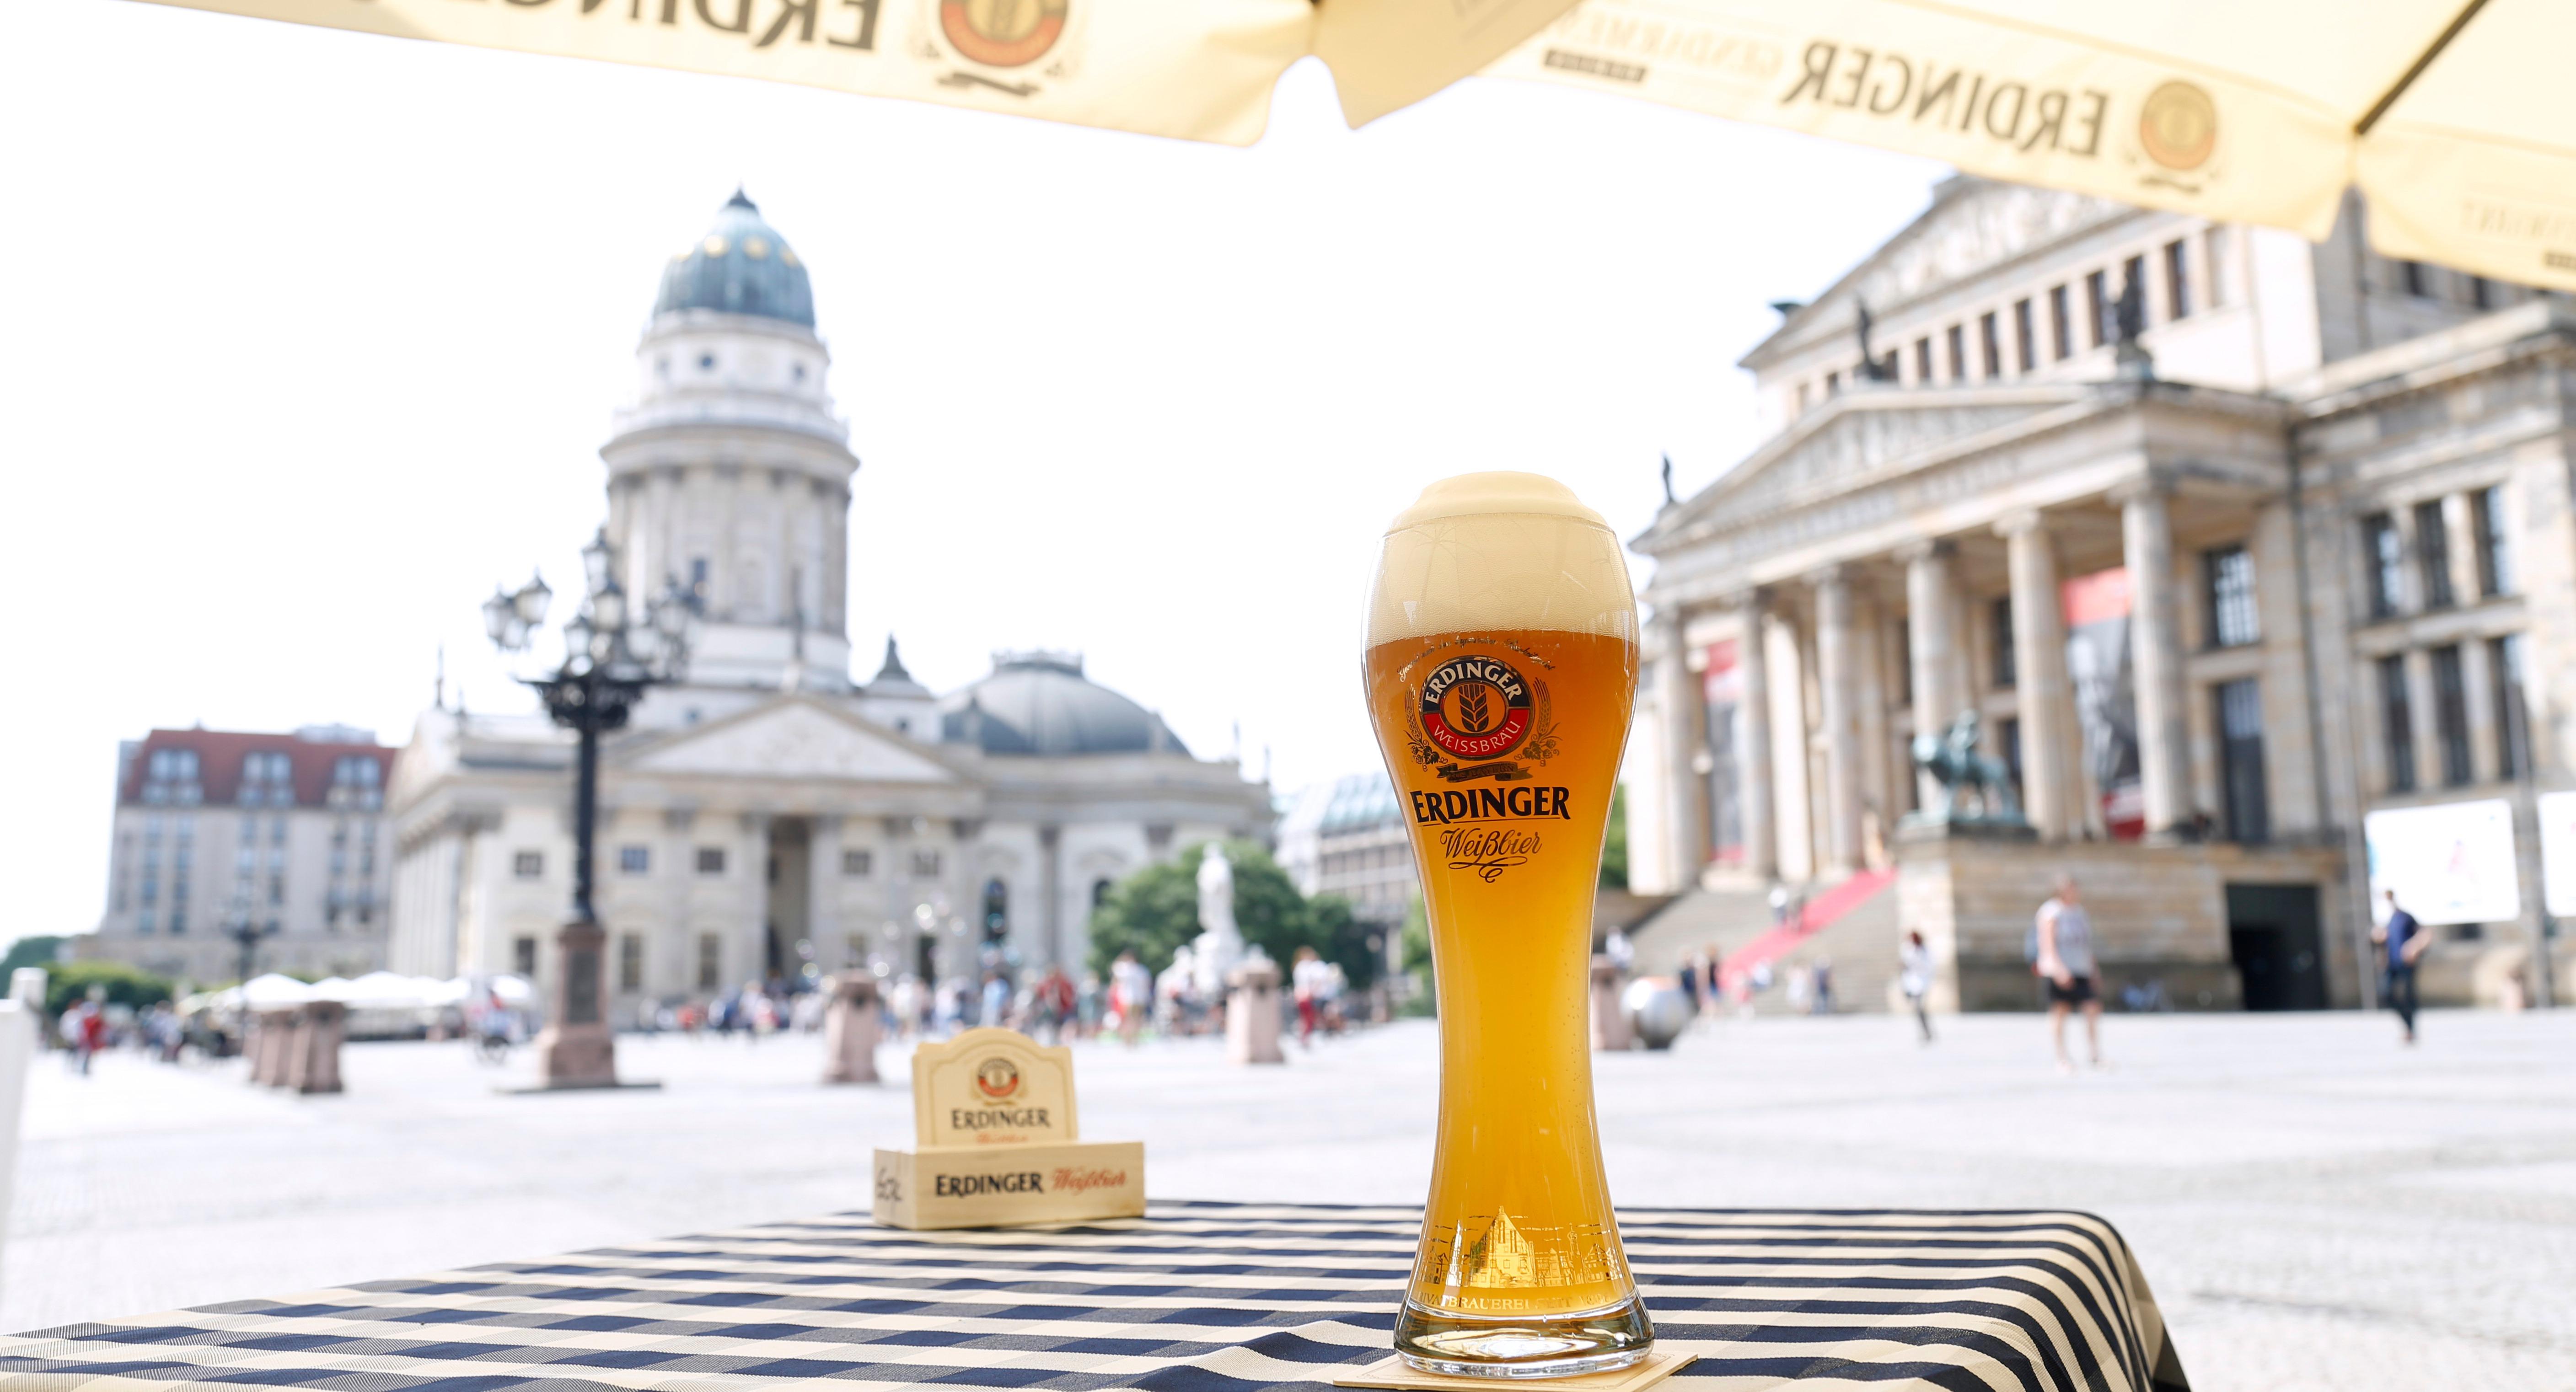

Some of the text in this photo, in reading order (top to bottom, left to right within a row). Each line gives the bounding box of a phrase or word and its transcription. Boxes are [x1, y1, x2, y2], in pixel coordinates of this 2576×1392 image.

[1425, 662, 1522, 703] ERDINGER
[1434, 721, 1521, 753] WEISSBRÄU
[1410, 787, 1571, 824] ERDINGER
[1440, 828, 1542, 869] Weißbier
[951, 1108, 1052, 1130] ERDINGER
[935, 1172, 1044, 1199] ERDINGER
